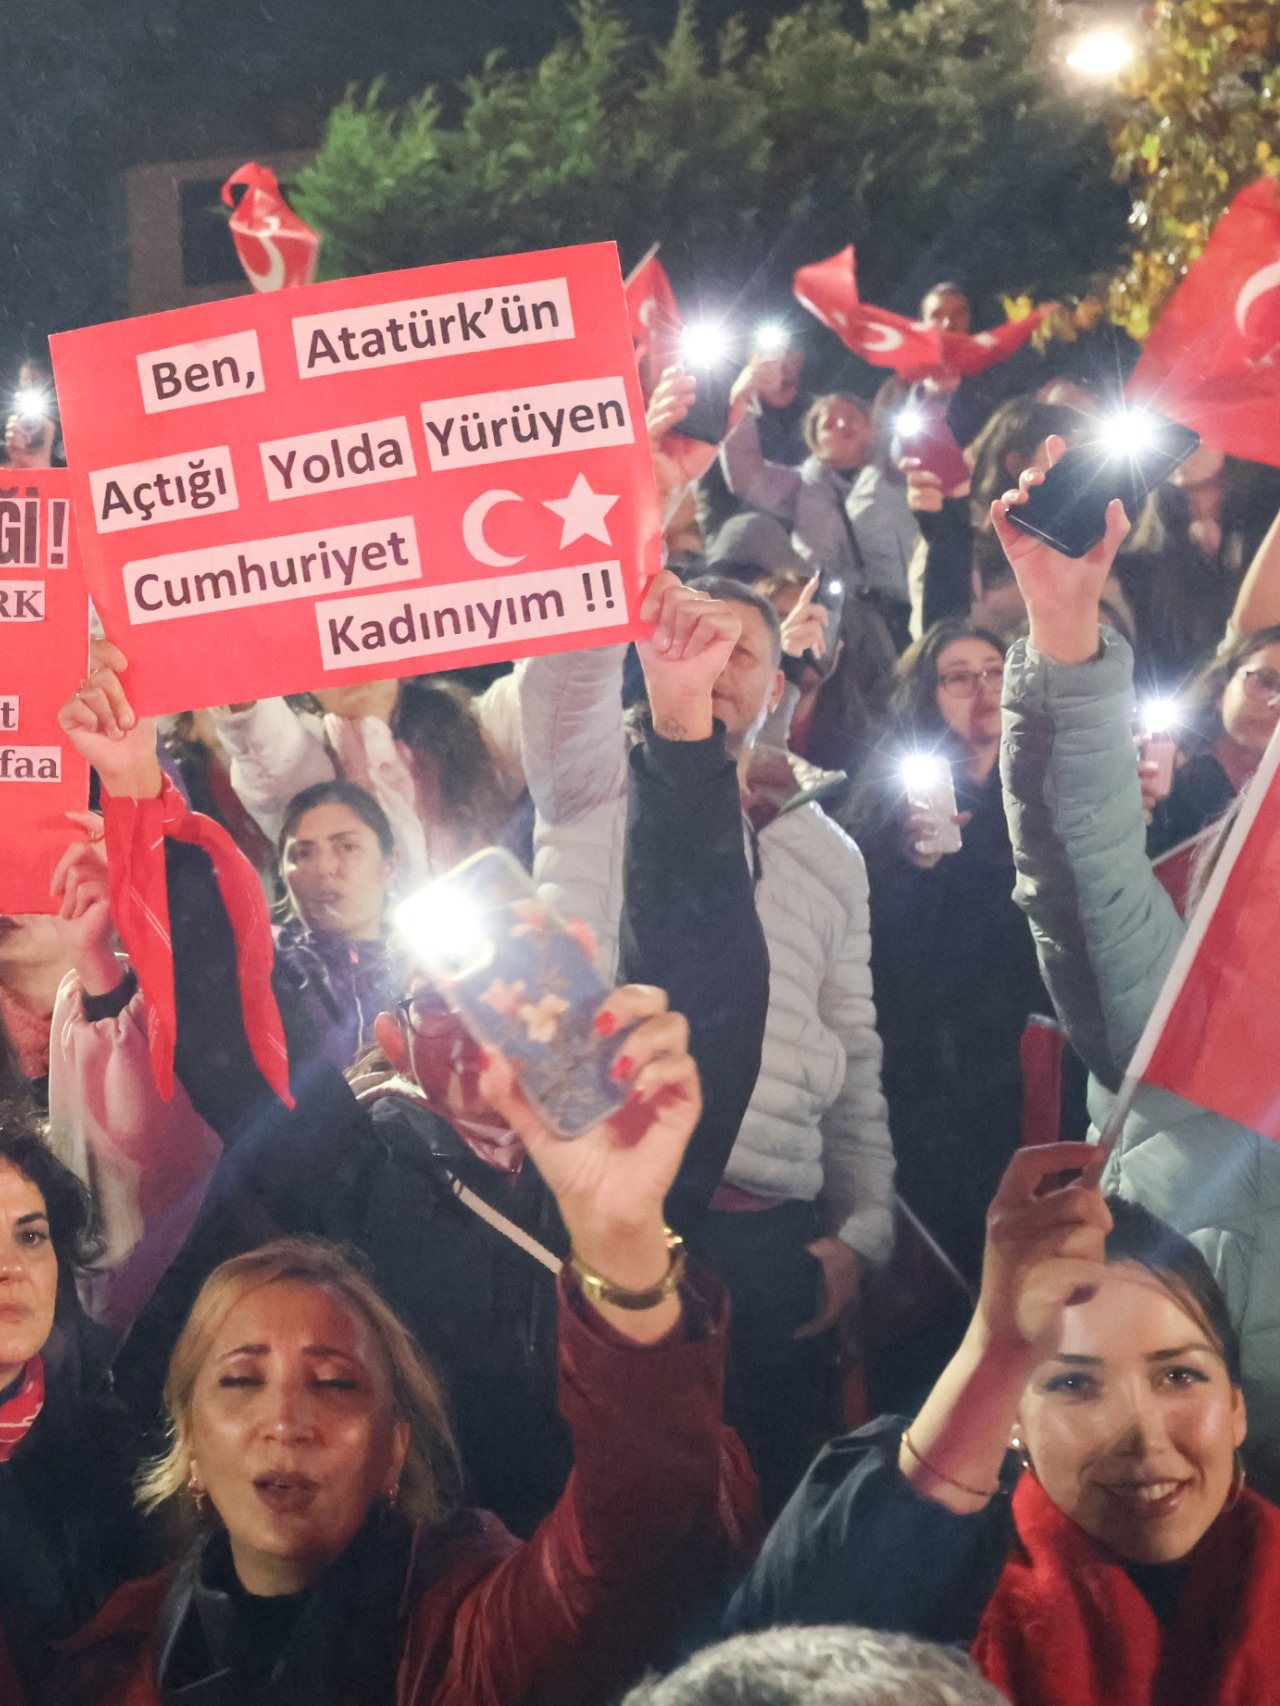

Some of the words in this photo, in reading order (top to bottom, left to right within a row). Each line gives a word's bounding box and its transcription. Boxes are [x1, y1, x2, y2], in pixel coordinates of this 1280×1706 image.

[152, 356, 255, 401] Ben,
[101, 458, 227, 521] Açtığı
[269, 432, 404, 490] Yolda
[425, 400, 625, 457] Yürüyen
[134, 532, 410, 613] Cumhuriyet
[328, 587, 565, 656] Kadınıyım
